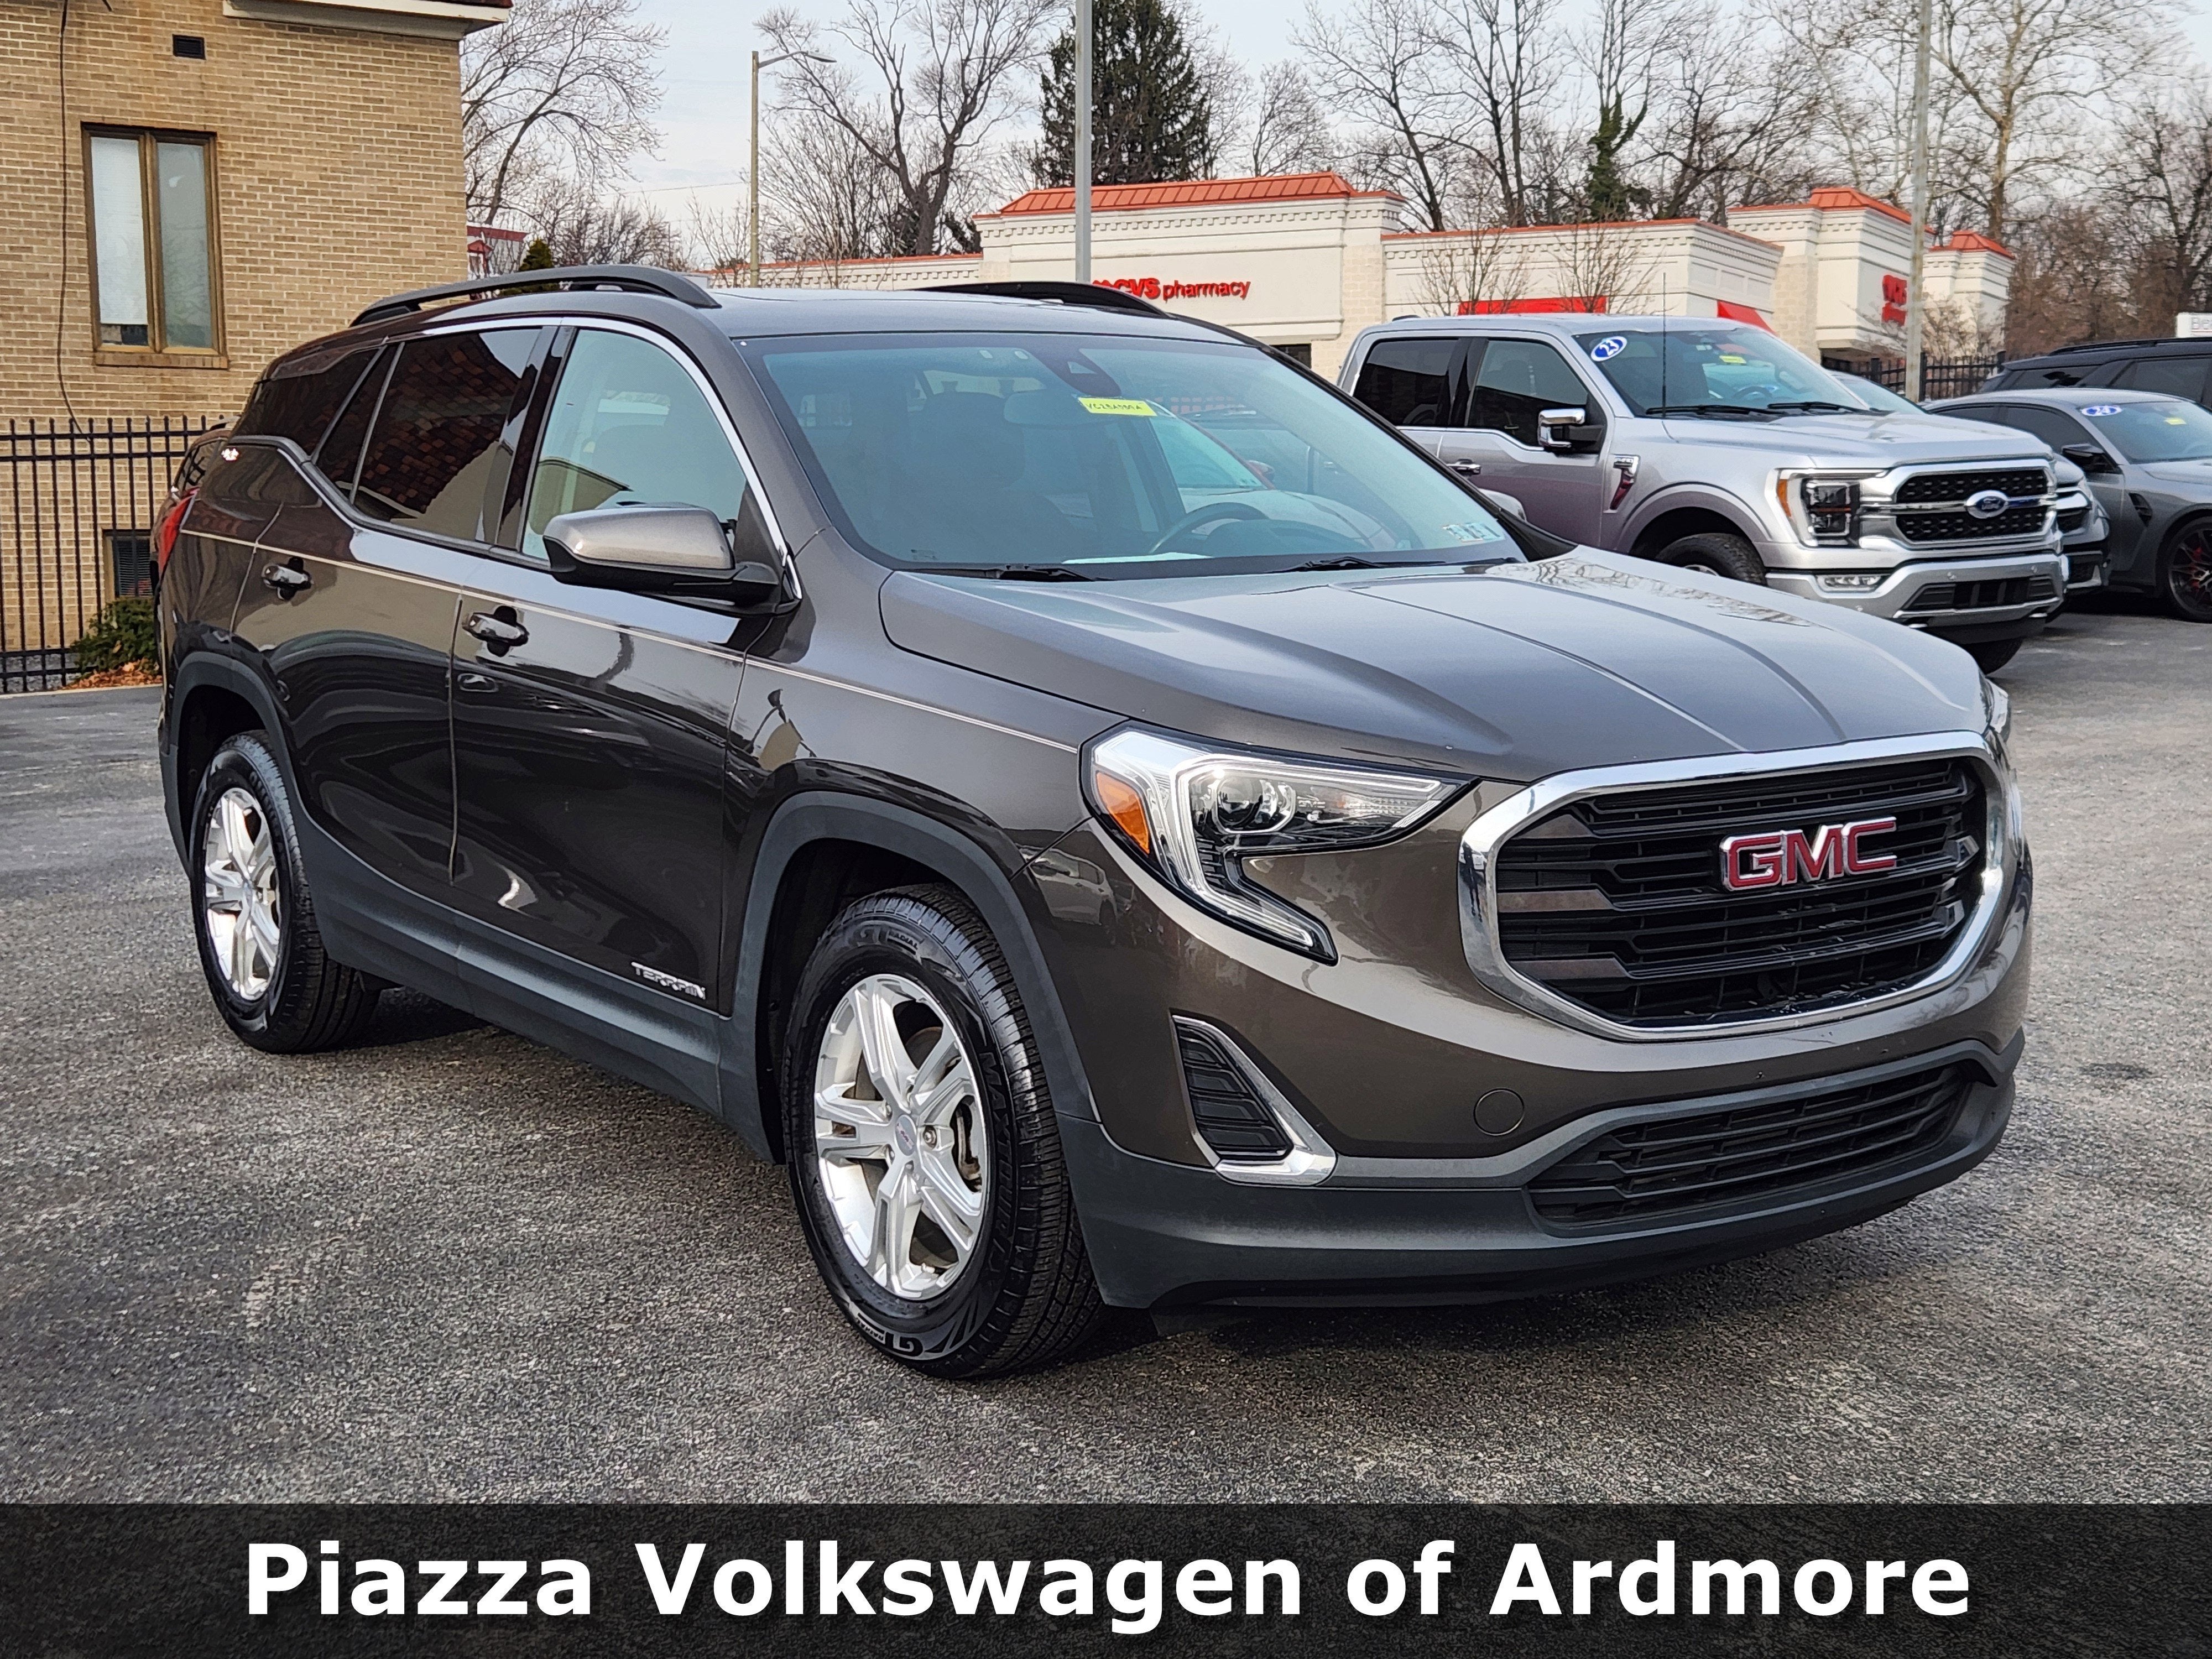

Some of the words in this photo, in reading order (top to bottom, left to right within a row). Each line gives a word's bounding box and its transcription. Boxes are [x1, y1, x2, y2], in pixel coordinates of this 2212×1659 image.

[1162, 280, 1251, 303] pharmacy
[1599, 339, 1620, 357] 23
[1719, 816, 1897, 891] GMC
[631, 962, 706, 1000] TERRAIN
